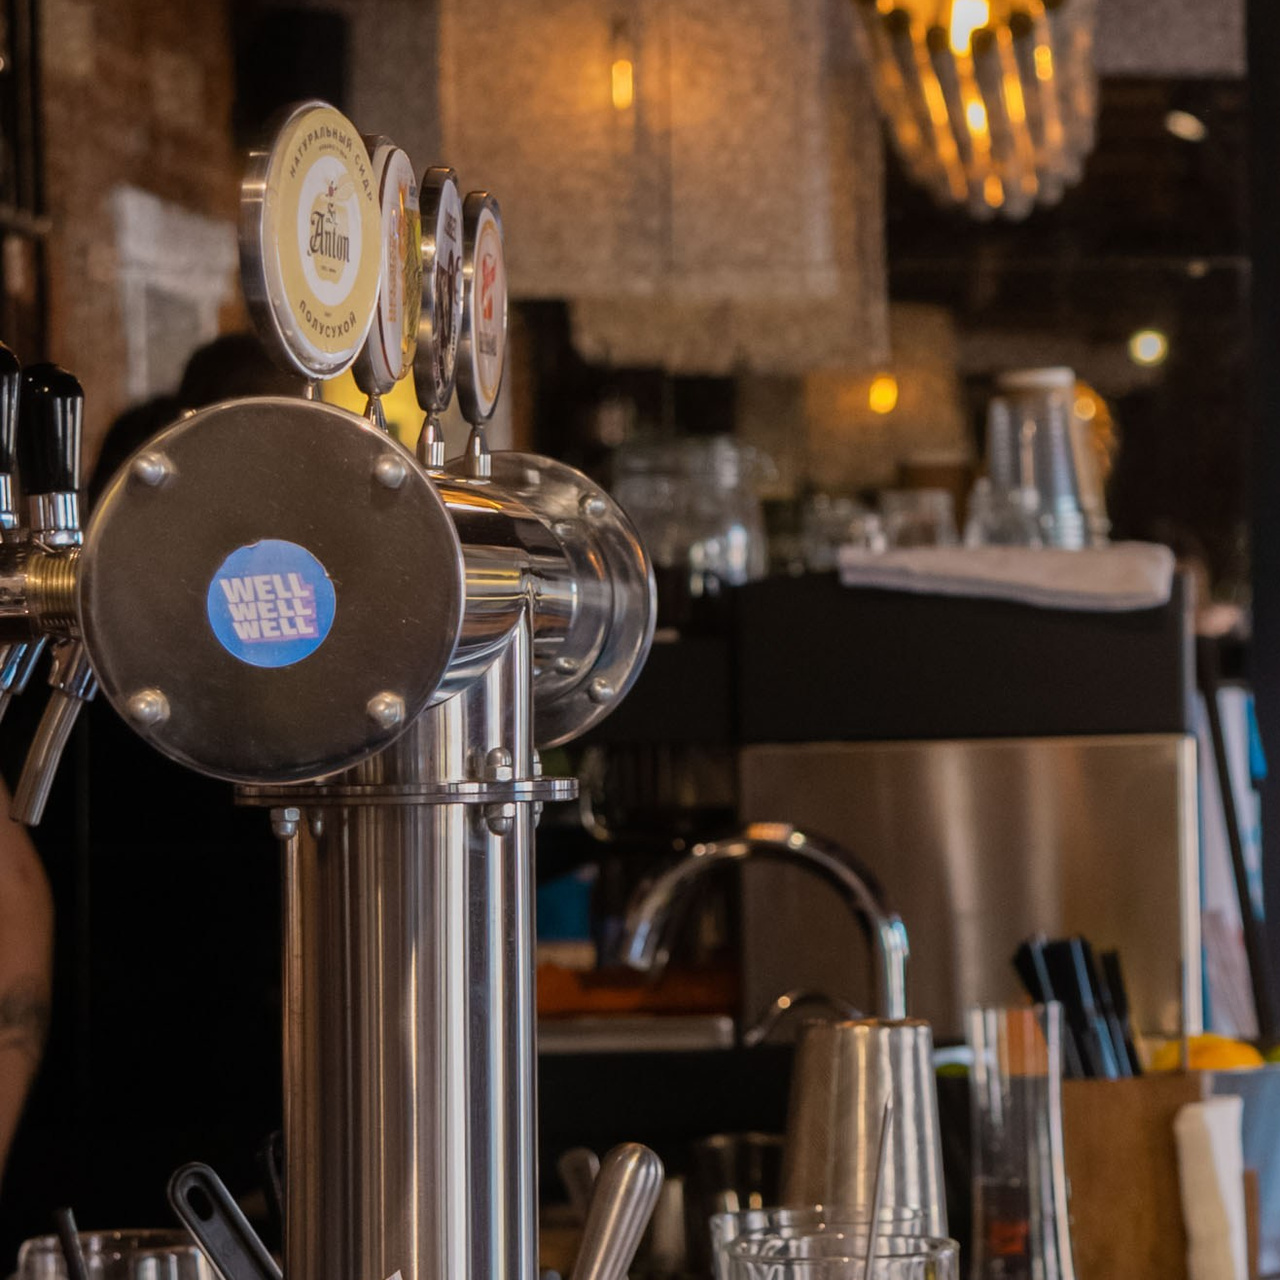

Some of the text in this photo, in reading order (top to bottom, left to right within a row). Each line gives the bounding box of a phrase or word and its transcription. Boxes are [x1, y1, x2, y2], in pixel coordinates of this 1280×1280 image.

[290, 126, 352, 178] НАТУРАЛЬНЫЙ
[307, 210, 350, 263] Anton
[299, 300, 357, 338] ПОЛУСУХОЙ
[219, 572, 314, 604] WELL
[228, 598, 315, 622] WELL
[232, 616, 318, 641] WELL
